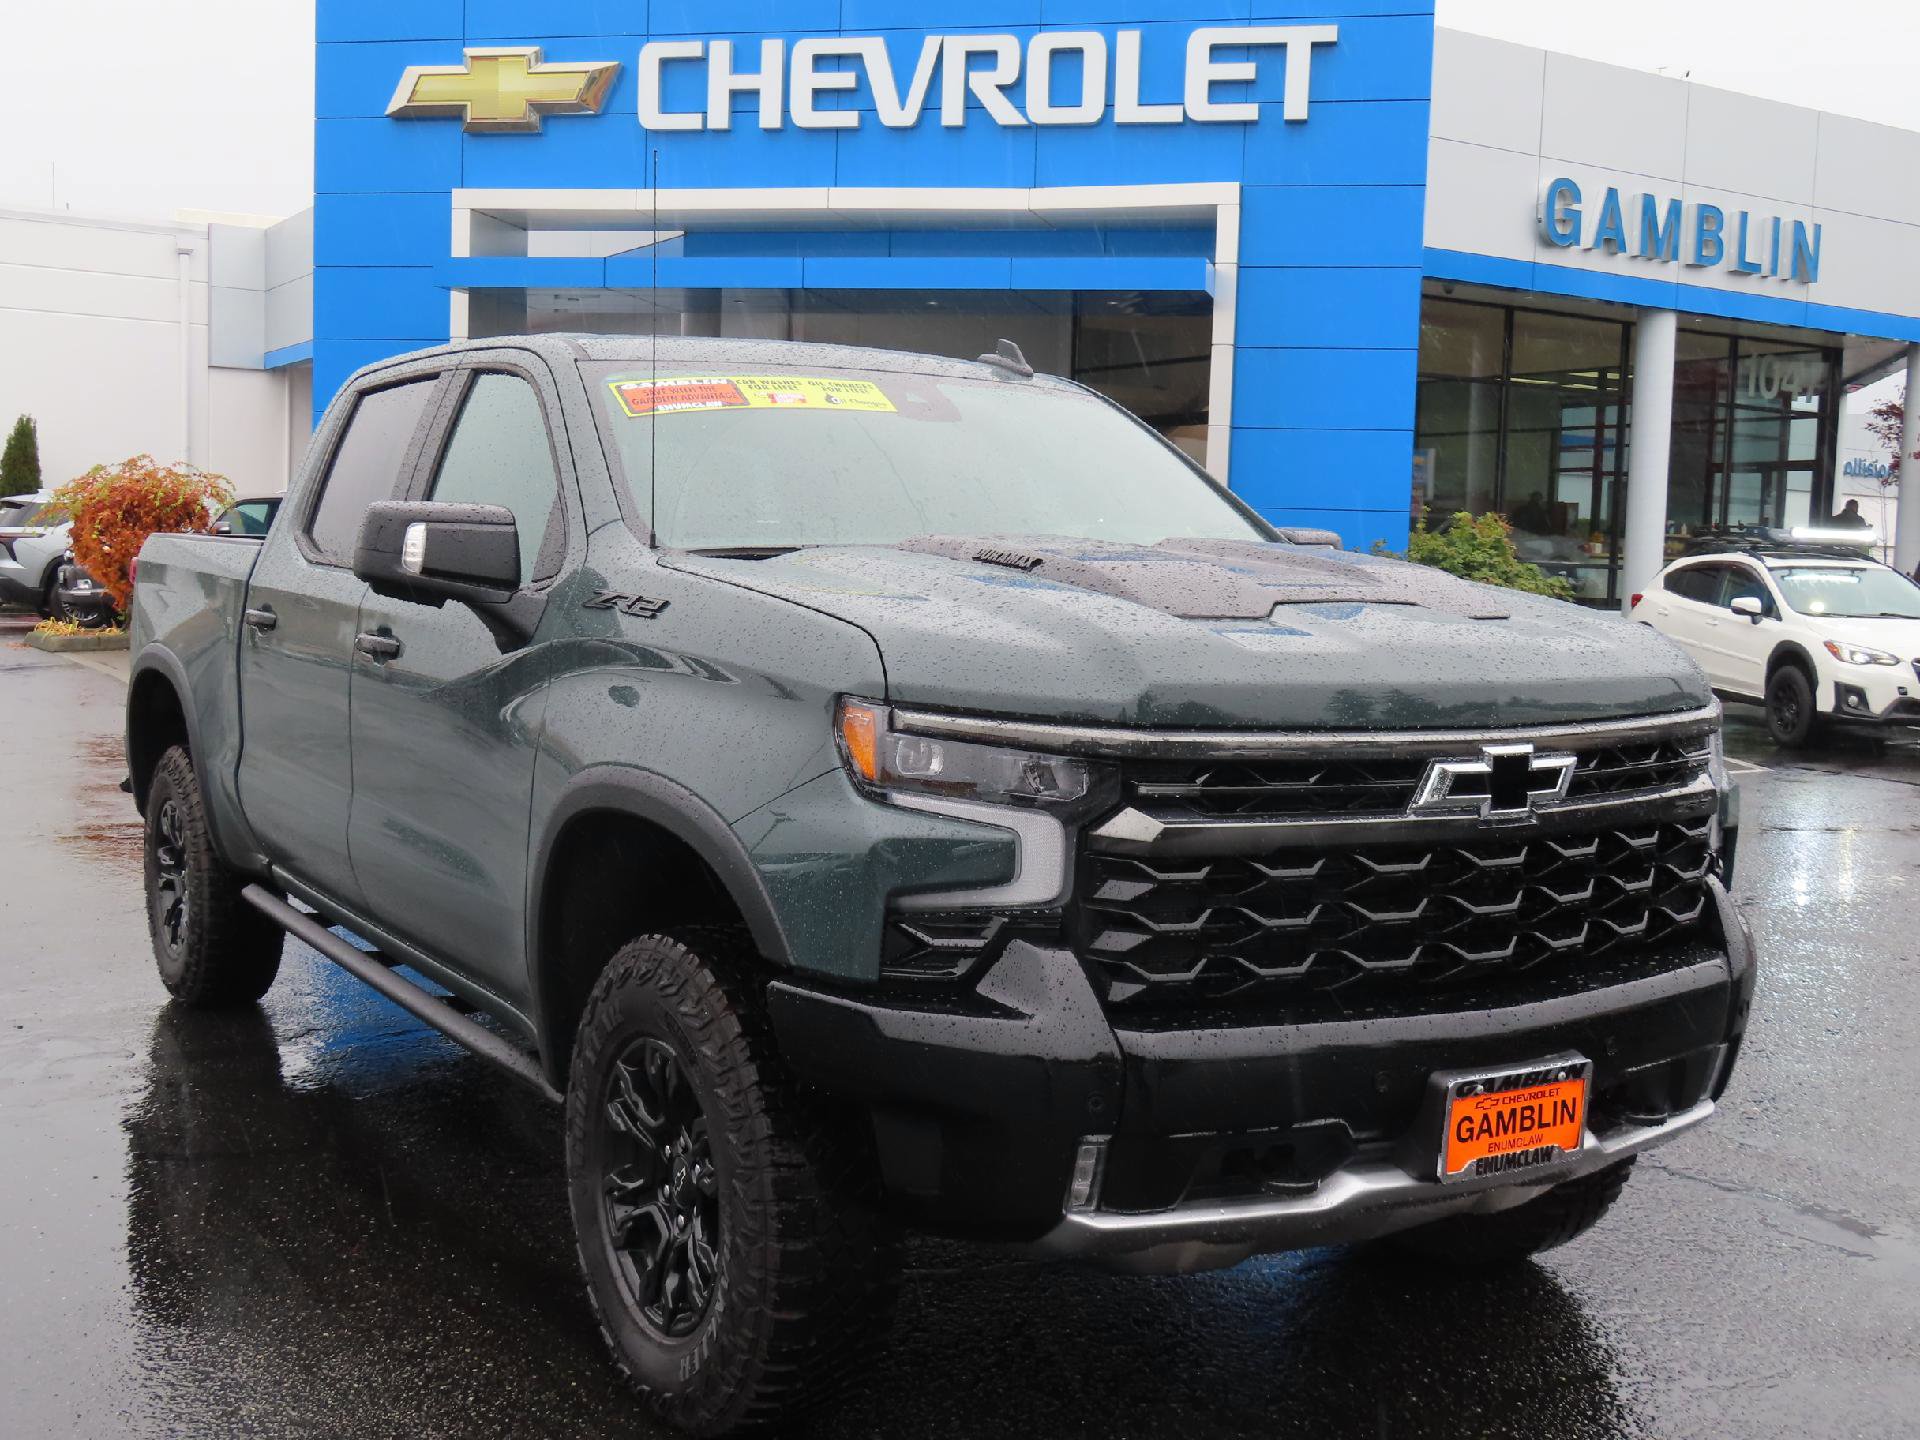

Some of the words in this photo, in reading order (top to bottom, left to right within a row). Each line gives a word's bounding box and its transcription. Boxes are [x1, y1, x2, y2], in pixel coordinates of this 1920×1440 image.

[637, 24, 1339, 131] CHEVROLET
[1541, 177, 1822, 284] GAMBLIN
[582, 588, 671, 619] ZR2
[1501, 1087, 1561, 1105] CHEVROLET
[1455, 1096, 1578, 1143] GAMBLIN
[1487, 1133, 1544, 1153] ENUMCLAW
[1476, 1145, 1555, 1175] ENUMCLAW
